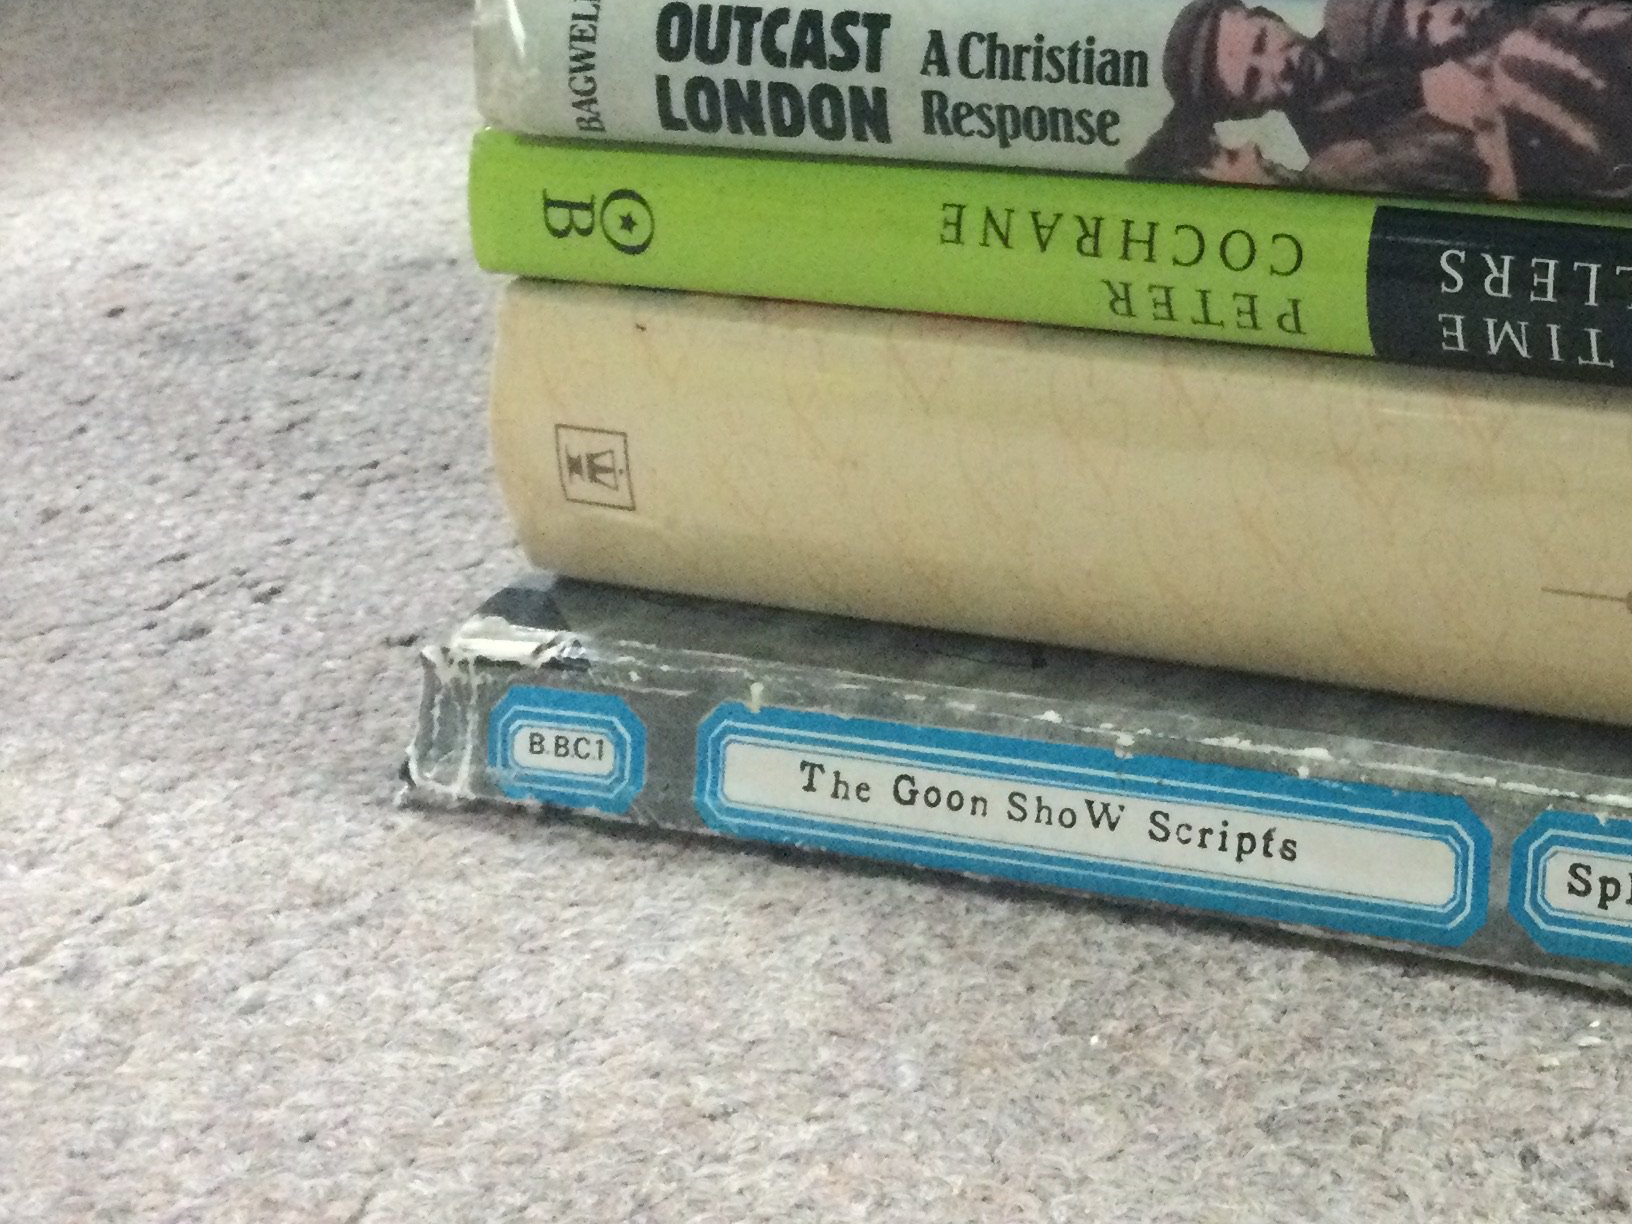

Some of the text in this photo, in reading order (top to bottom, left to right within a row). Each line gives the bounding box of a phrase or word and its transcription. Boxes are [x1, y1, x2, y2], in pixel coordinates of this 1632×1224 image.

[655, 1, 892, 73] OUTCAST
[920, 29, 1149, 88] A Christian
[655, 75, 893, 144] LONDON
[920, 90, 1121, 148] Response
[938, 203, 1305, 278] COCHRANE
[1102, 278, 1306, 336] PETER
[1440, 312, 1614, 368] TIME
[799, 760, 1301, 864] The Goon ShoW Scripts
